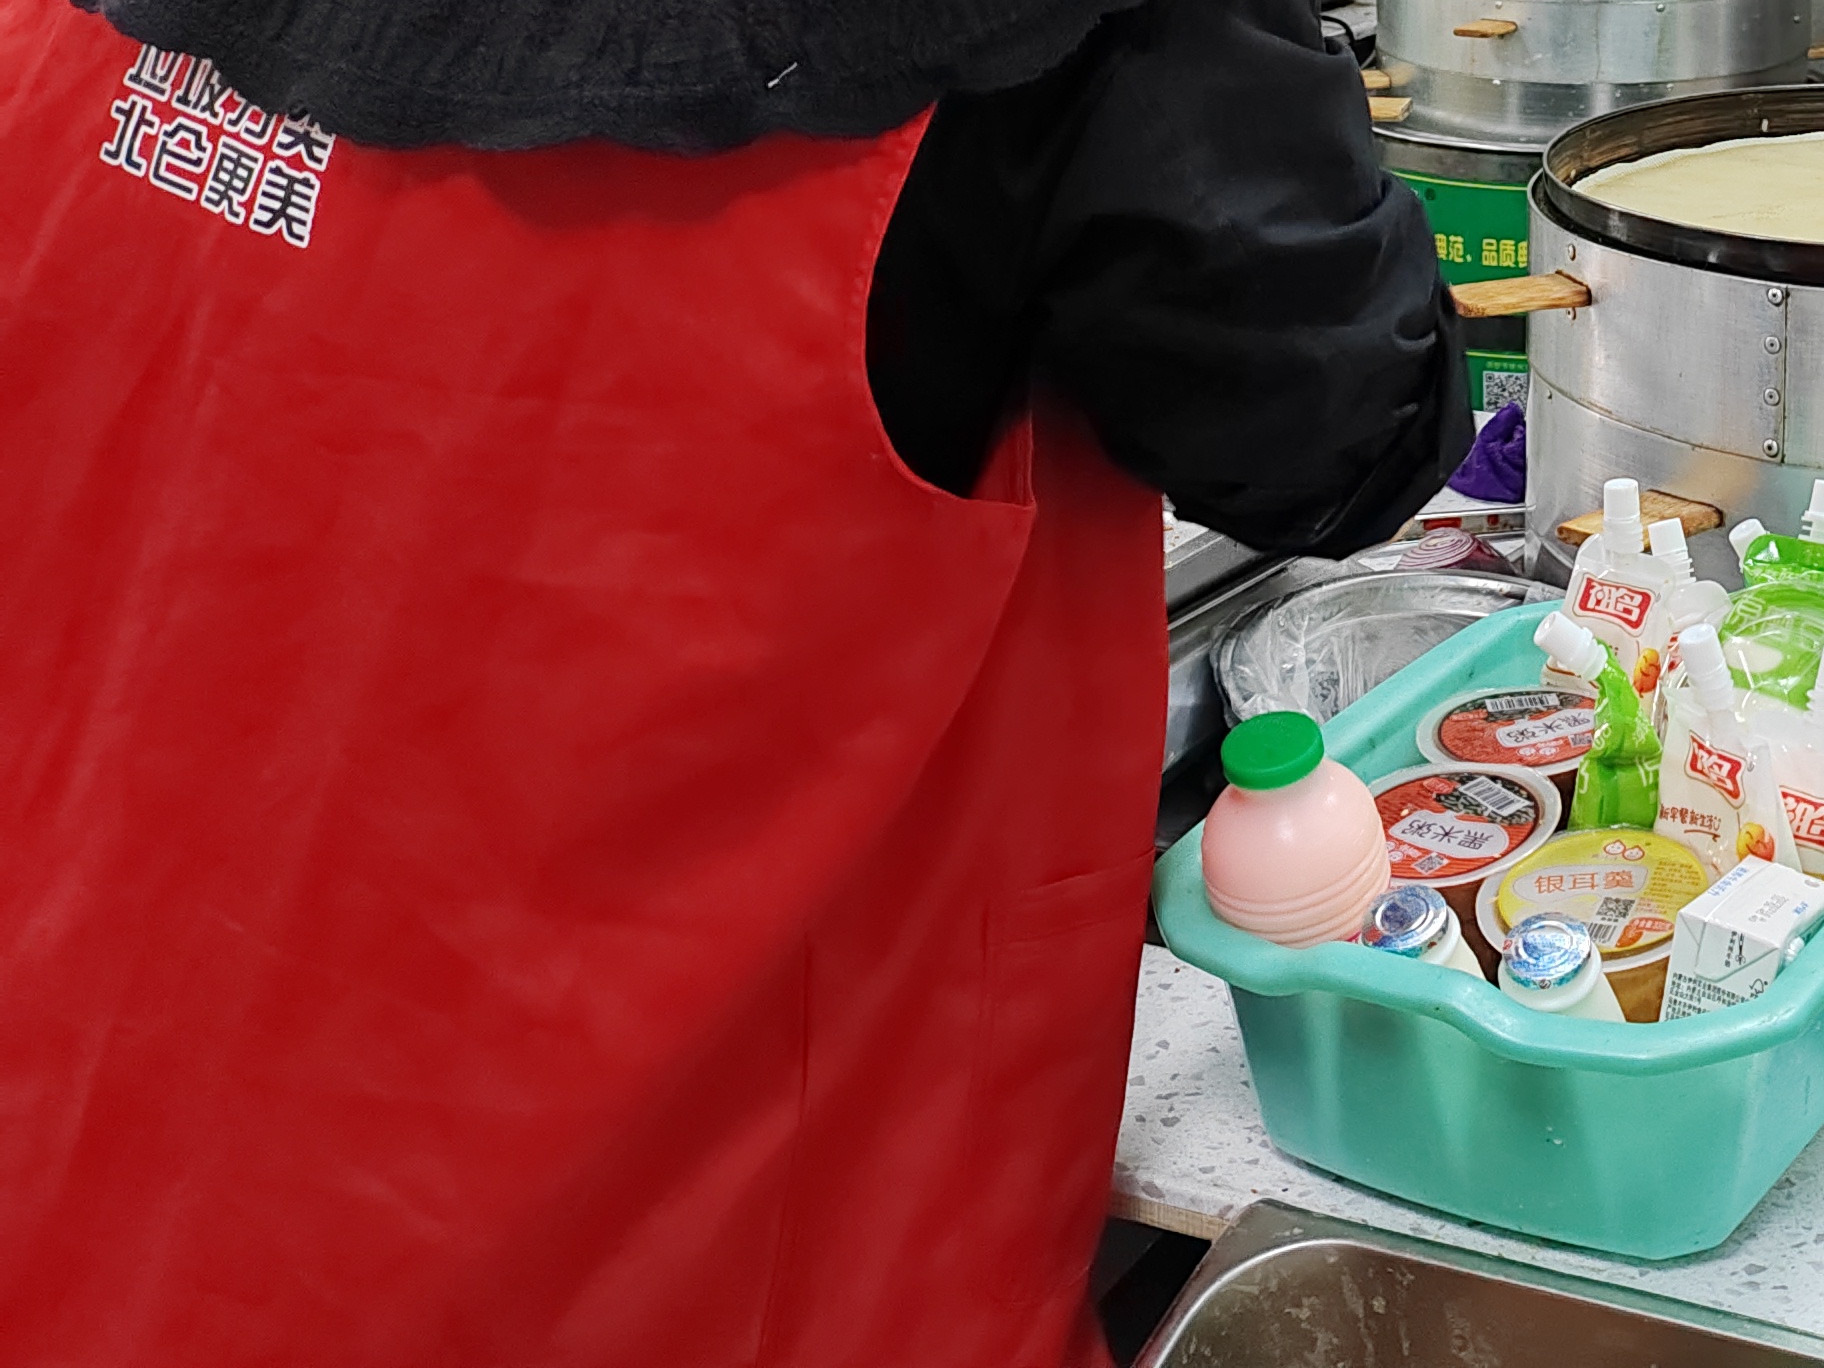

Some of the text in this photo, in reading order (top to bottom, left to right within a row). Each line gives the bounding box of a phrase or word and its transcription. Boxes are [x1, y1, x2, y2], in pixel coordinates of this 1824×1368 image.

[100, 93, 320, 248] 北仑更美
[1505, 711, 1592, 744] 黑米粥
[1401, 818, 1495, 851] 黑米粥
[1534, 869, 1635, 895] 银耳羹
